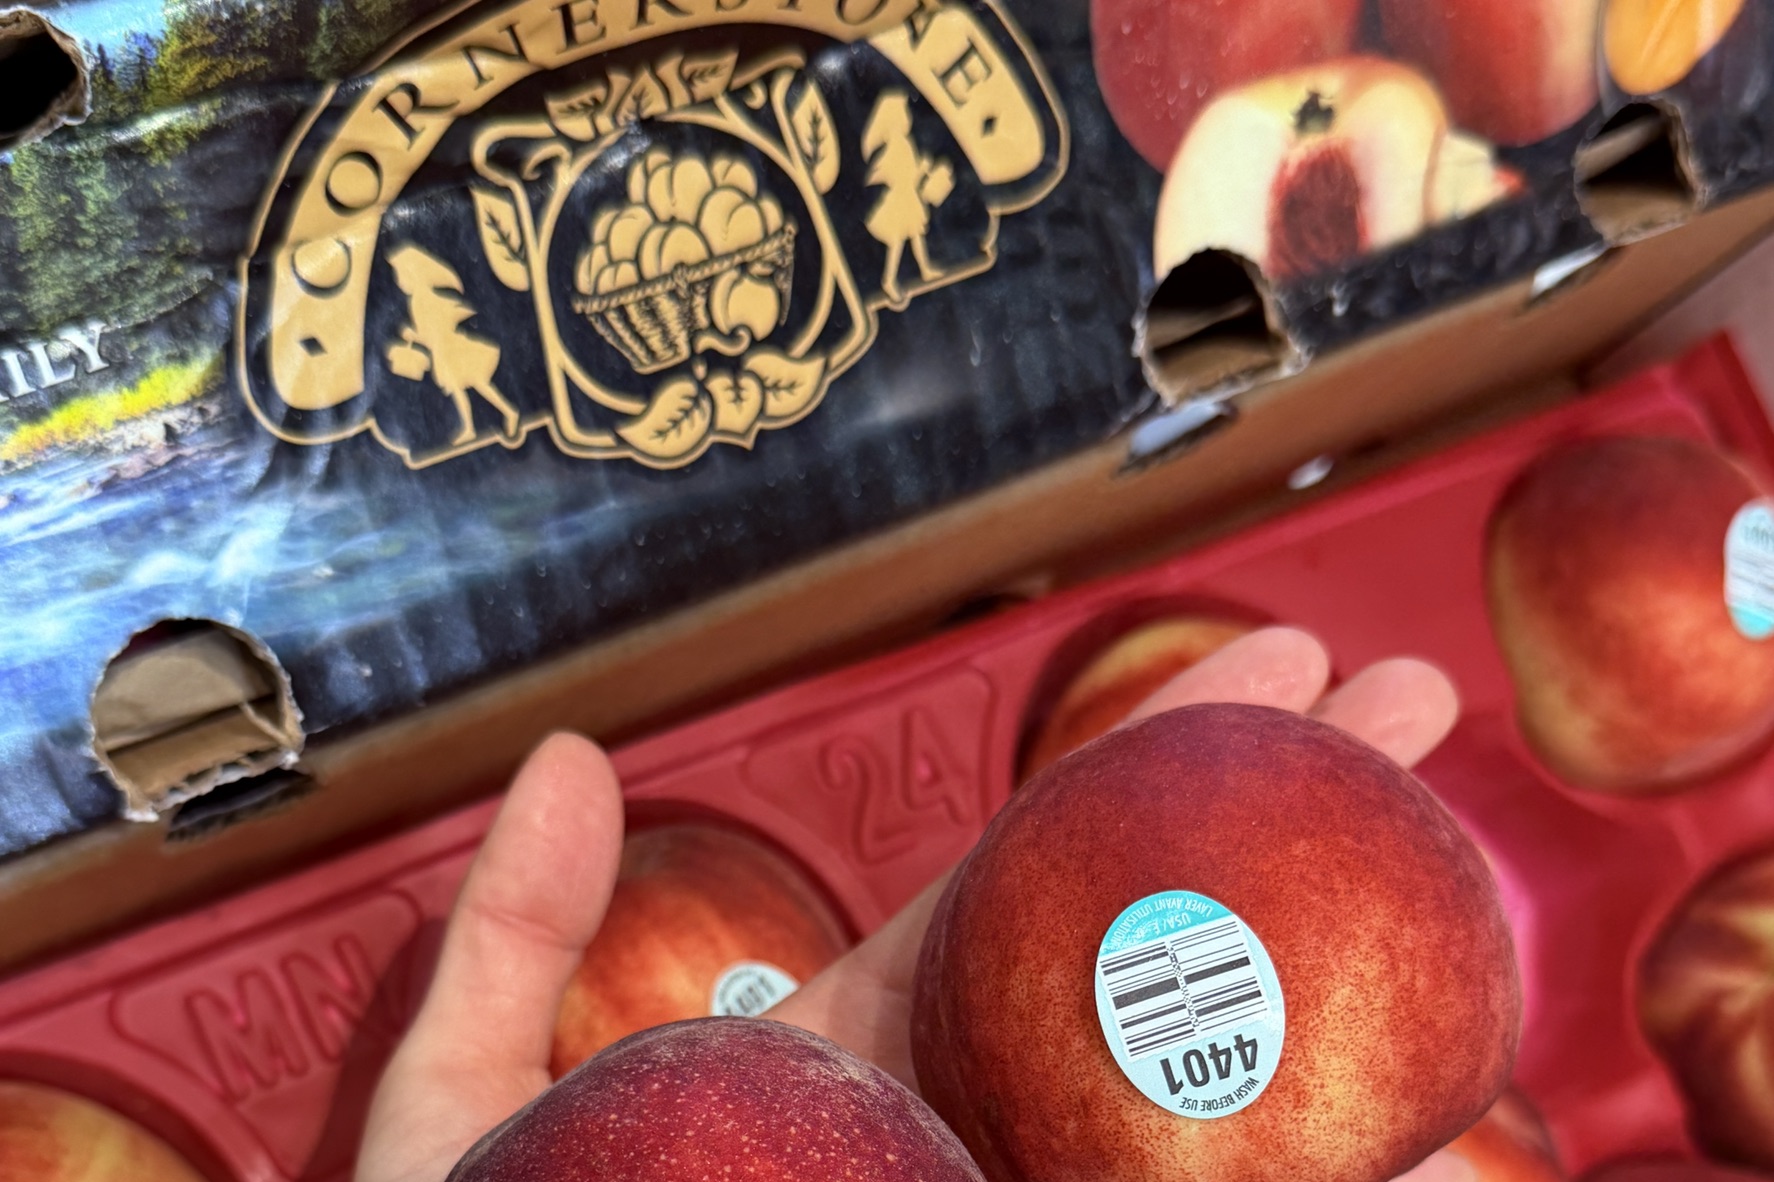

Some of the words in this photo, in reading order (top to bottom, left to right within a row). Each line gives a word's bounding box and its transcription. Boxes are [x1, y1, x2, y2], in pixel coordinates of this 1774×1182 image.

[0, 320, 110, 400] ILY
[1160, 1034, 1258, 1095] 4401
[1234, 1077, 1259, 1101] WASH
[1179, 1096, 1198, 1110] USE
[1200, 1094, 1235, 1112] BEFORE
